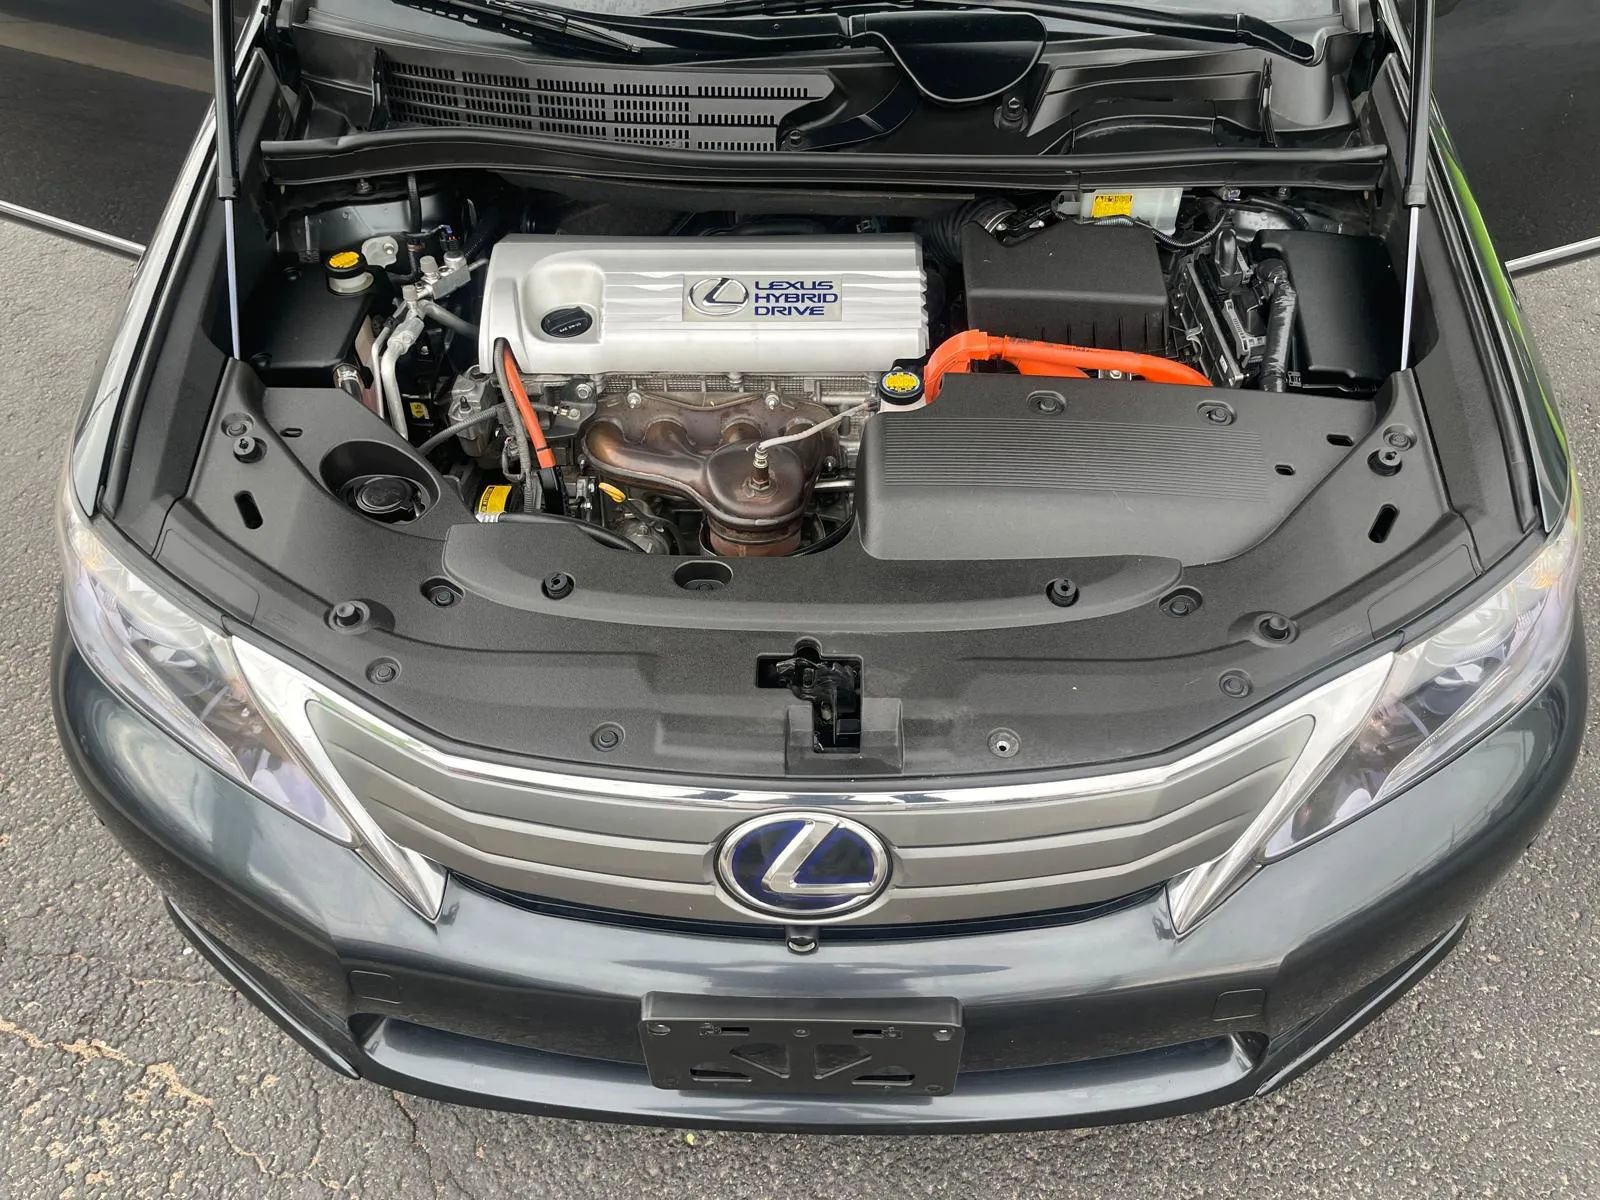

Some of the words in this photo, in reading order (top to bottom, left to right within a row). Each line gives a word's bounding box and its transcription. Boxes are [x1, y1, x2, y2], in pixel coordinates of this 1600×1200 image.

[754, 280, 834, 291] LEXUS
[754, 293, 838, 304] HYBRID
[754, 306, 825, 316] DRIVE
